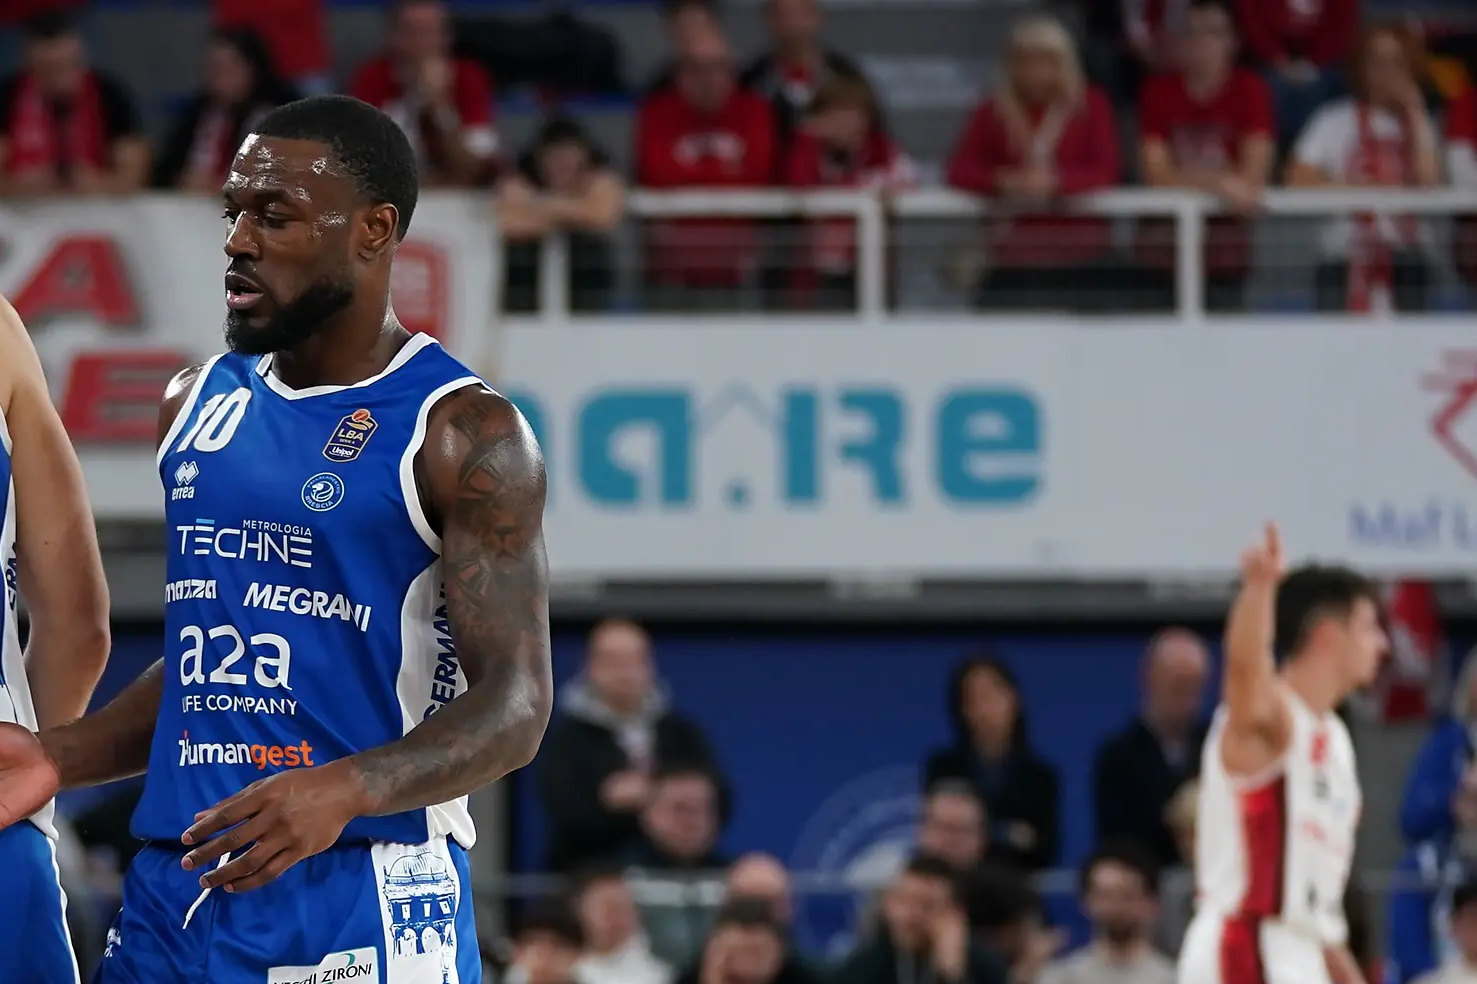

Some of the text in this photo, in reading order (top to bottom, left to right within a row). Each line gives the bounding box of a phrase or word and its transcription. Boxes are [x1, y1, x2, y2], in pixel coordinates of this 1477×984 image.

[176, 387, 252, 453] 10
[337, 428, 364, 441] LBA
[331, 446, 355, 456] Unipol
[304, 495, 334, 508] BRESCIA
[243, 519, 312, 537] METROLOGIA
[177, 518, 312, 568] TECHNE
[243, 583, 372, 632] MEGRANI
[180, 625, 293, 690] a2a
[206, 694, 297, 715] COMPANY
[178, 729, 314, 770] Humangest
[321, 962, 373, 982] ZIRONI
